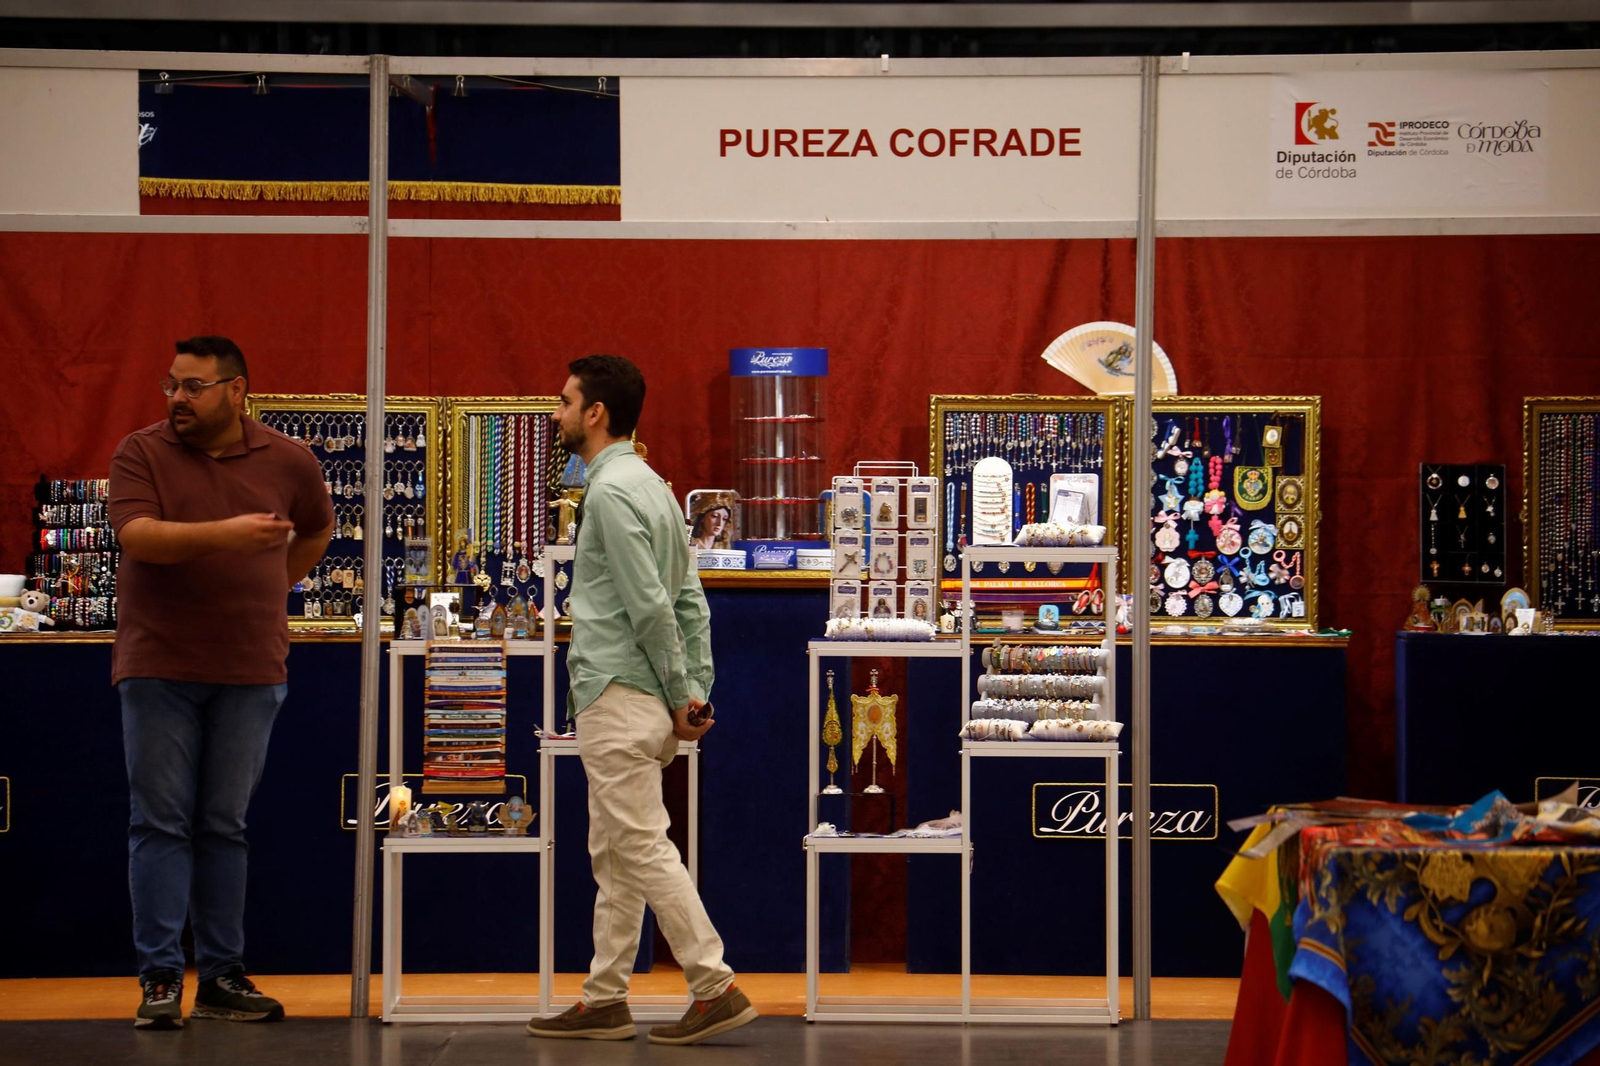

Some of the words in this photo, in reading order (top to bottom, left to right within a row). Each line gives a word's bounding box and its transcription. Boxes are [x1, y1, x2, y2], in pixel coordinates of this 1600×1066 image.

[1399, 120, 1450, 130] IPRODECO
[719, 129, 879, 157] PUREZA
[889, 128, 1082, 157] COFRADE
[1276, 150, 1357, 166] Diputación
[1367, 149, 1407, 157] Diputación
[1275, 167, 1294, 179] de
[1298, 166, 1357, 179] Córdoba
[1039, 790, 1212, 834] Purza
